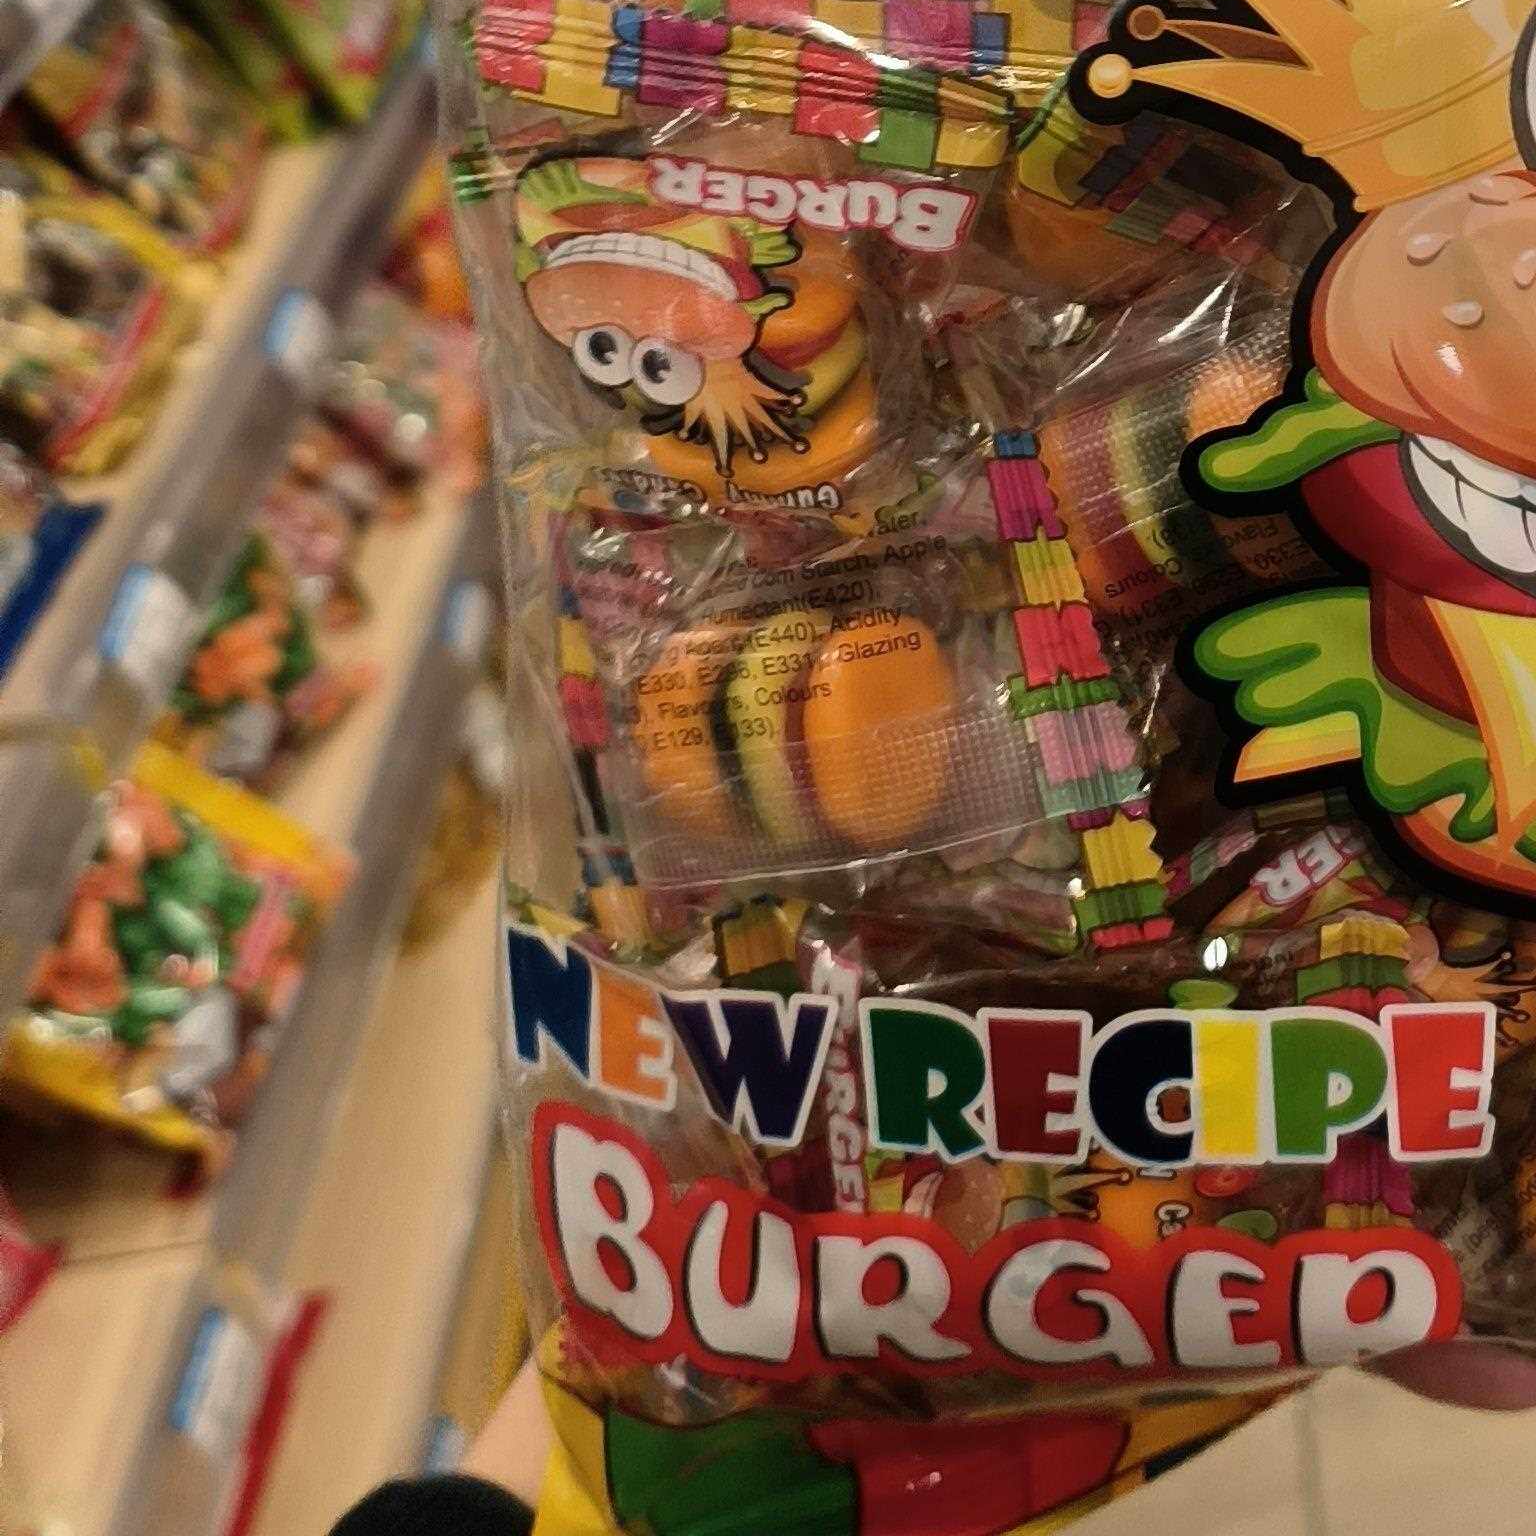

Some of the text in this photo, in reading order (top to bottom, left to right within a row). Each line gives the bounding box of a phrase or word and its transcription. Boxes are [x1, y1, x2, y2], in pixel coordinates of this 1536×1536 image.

[652, 156, 980, 253] BURGER
[834, 626, 922, 664] Glazing
[503, 926, 1497, 1168] NEW RECIPE
